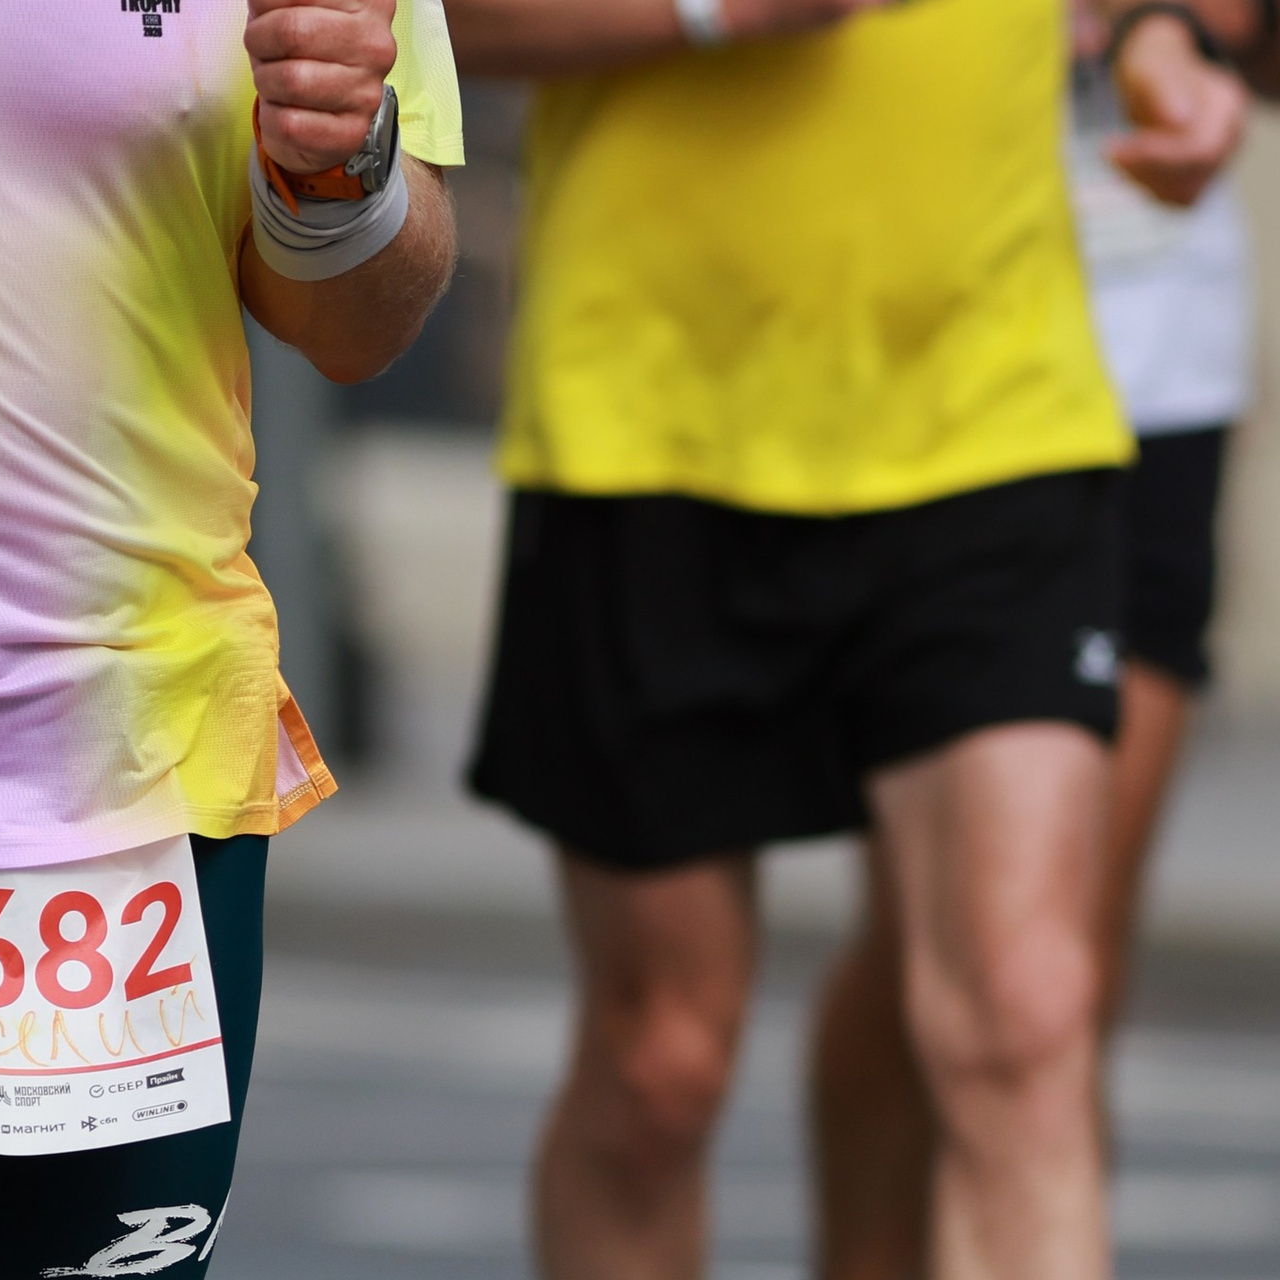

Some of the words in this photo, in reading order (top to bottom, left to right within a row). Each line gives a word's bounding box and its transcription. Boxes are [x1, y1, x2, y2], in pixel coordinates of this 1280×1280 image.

[14, 1082, 71, 1096] МОСКОВСКИЙ
[108, 1080, 143, 1093] СБЕР
[150, 1073, 178, 1085] Прайм
[15, 1096, 40, 1106] СПОРТ
[137, 1104, 175, 1119] WINLINE
[13, 1123, 66, 1133] магнит
[100, 1117, 118, 1125] сбп
[39, 1187, 231, 1279] B
